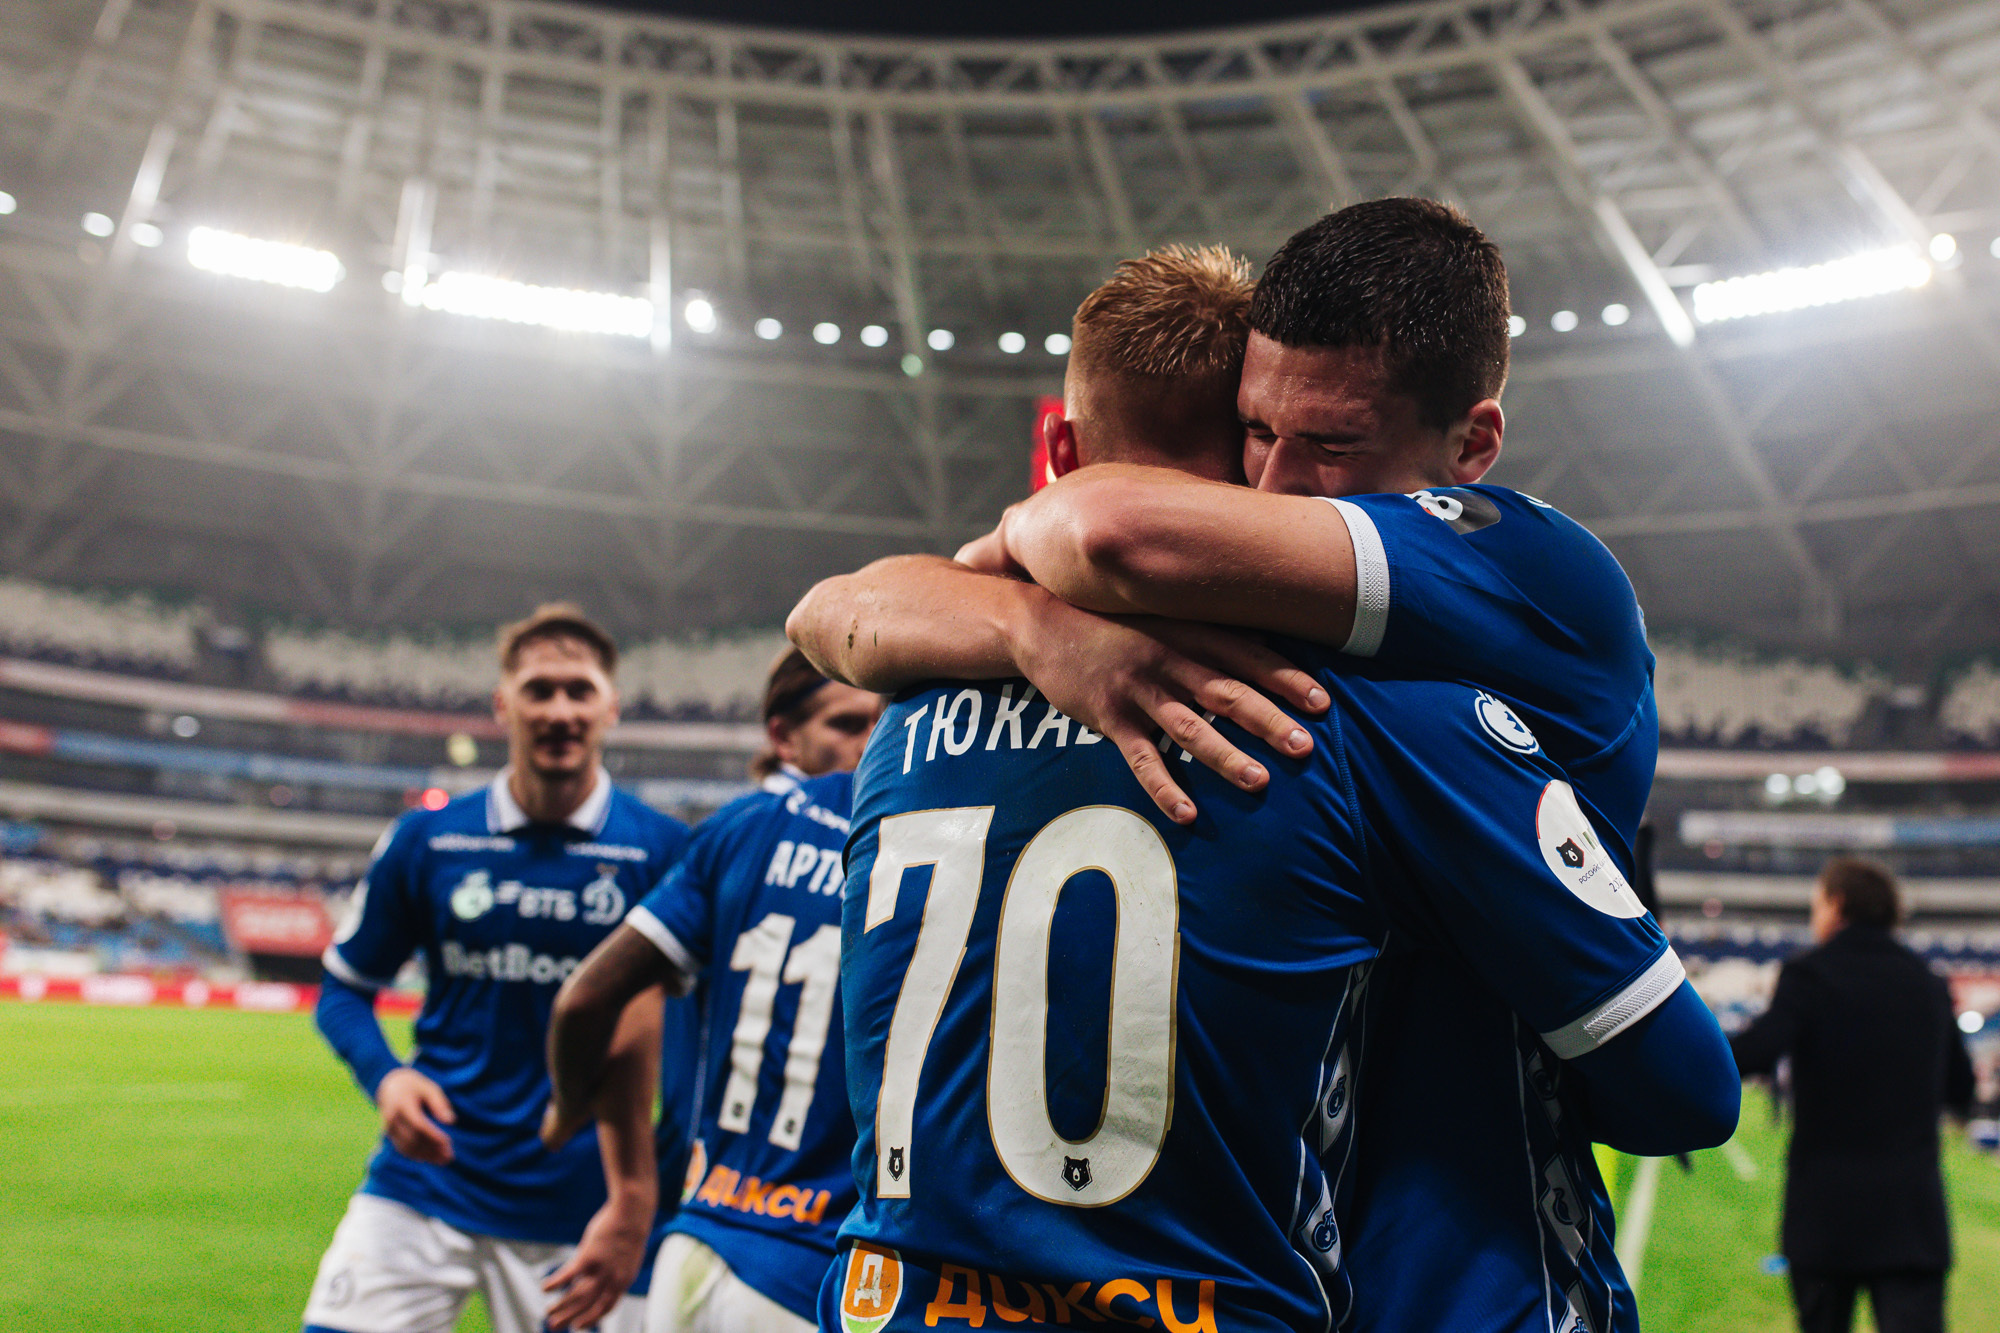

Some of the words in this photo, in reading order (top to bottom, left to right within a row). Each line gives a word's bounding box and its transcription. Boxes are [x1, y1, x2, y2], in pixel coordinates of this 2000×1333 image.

[764, 840, 846, 898] АРТУ
[441, 941, 582, 984] BetBoo
[717, 912, 842, 1151] 11
[864, 804, 1181, 1208] 70
